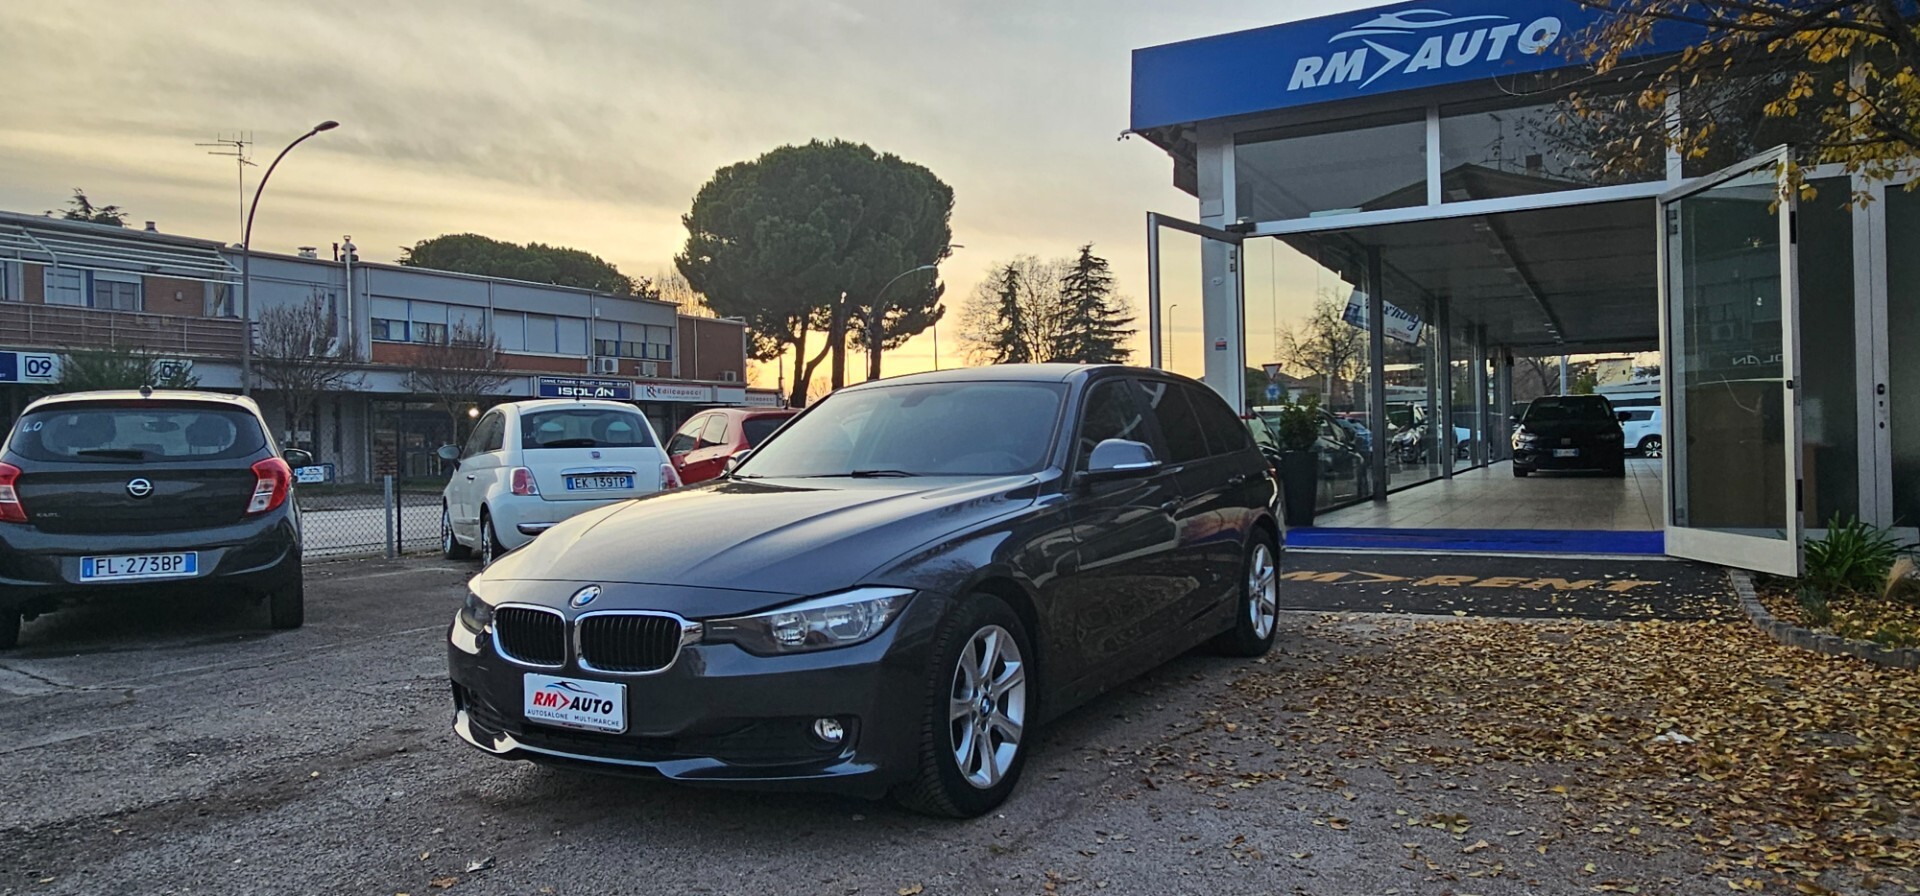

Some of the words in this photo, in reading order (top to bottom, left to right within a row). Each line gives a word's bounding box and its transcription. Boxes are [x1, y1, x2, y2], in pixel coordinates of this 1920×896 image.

[1286, 47, 1369, 91] RM
[1403, 16, 1562, 74] AUTO
[27, 359, 52, 374] 09
[558, 387, 614, 399] ISOLAN
[1280, 571, 1350, 582] M
[1411, 575, 1661, 592] RENT
[533, 691, 558, 708] RM
[569, 696, 614, 715] AUTO
[527, 709, 569, 720] AUTOSALONE
[574, 715, 620, 727] MULTIMARCHE
